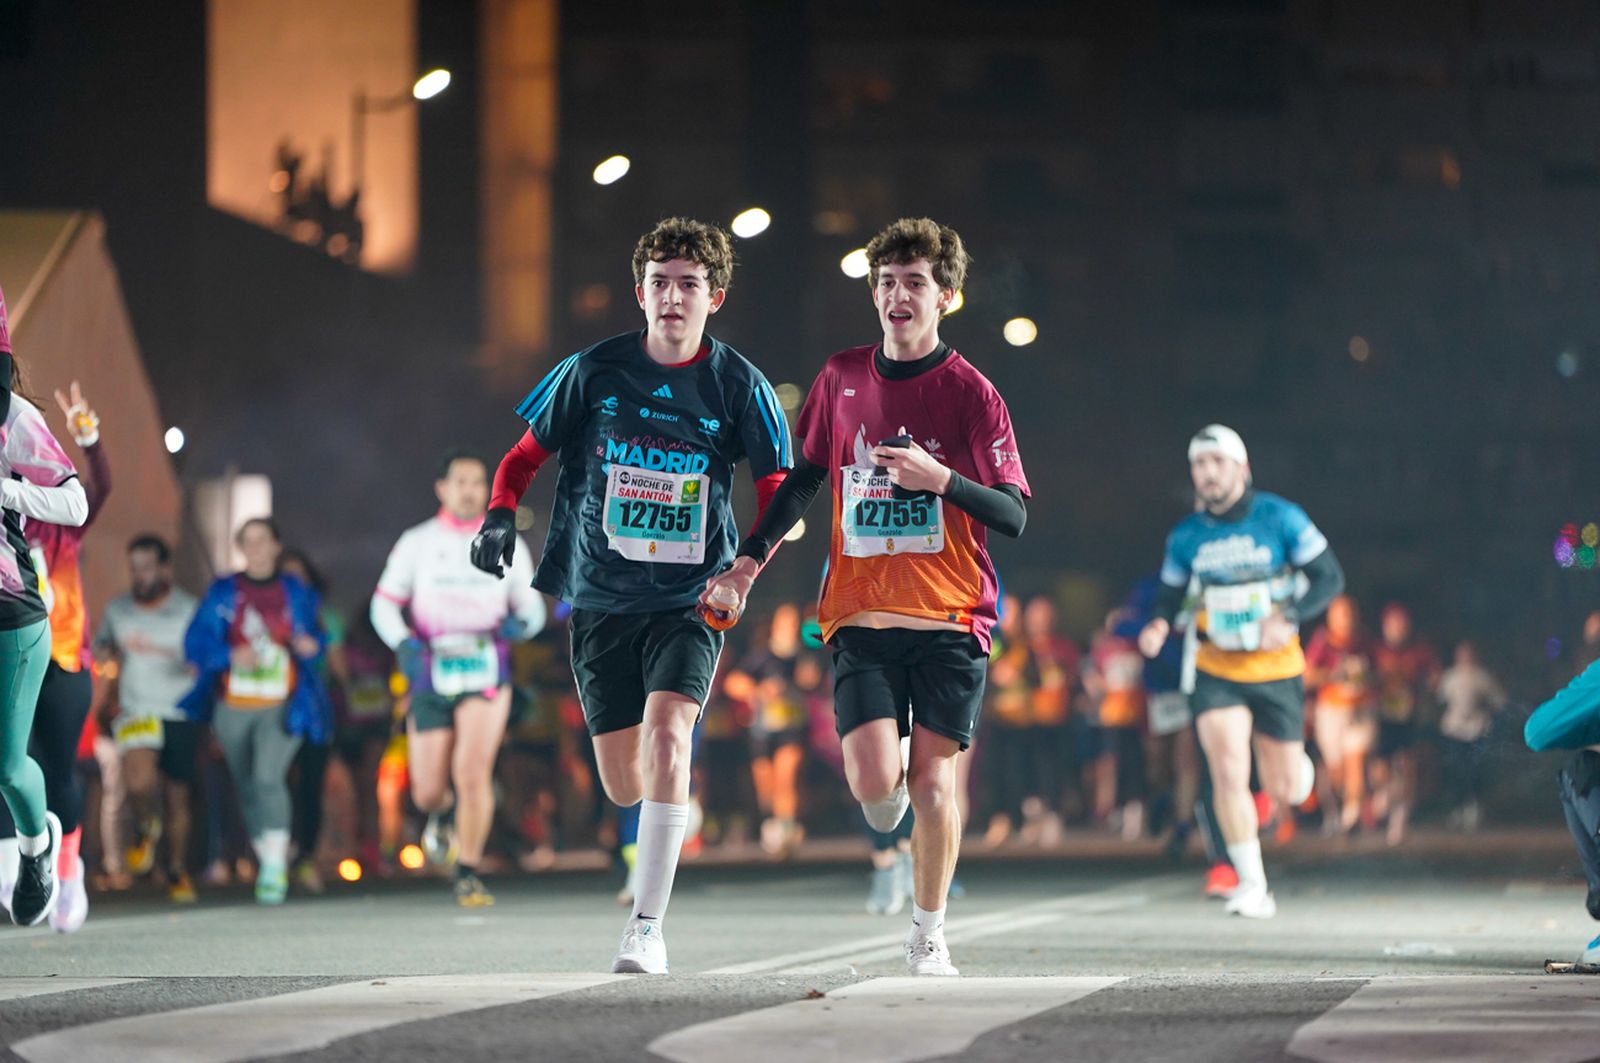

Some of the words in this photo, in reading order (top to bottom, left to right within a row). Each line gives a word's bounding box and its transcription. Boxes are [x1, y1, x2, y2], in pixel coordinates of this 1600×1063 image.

[651, 411, 678, 423] ZURICH
[605, 438, 709, 474] MADRID
[618, 487, 638, 499] SAN
[639, 489, 673, 504] ANTÓN
[631, 478, 660, 490] NOCHE
[662, 482, 674, 492] DE
[619, 500, 691, 533] 12755
[856, 499, 928, 528] 12755
